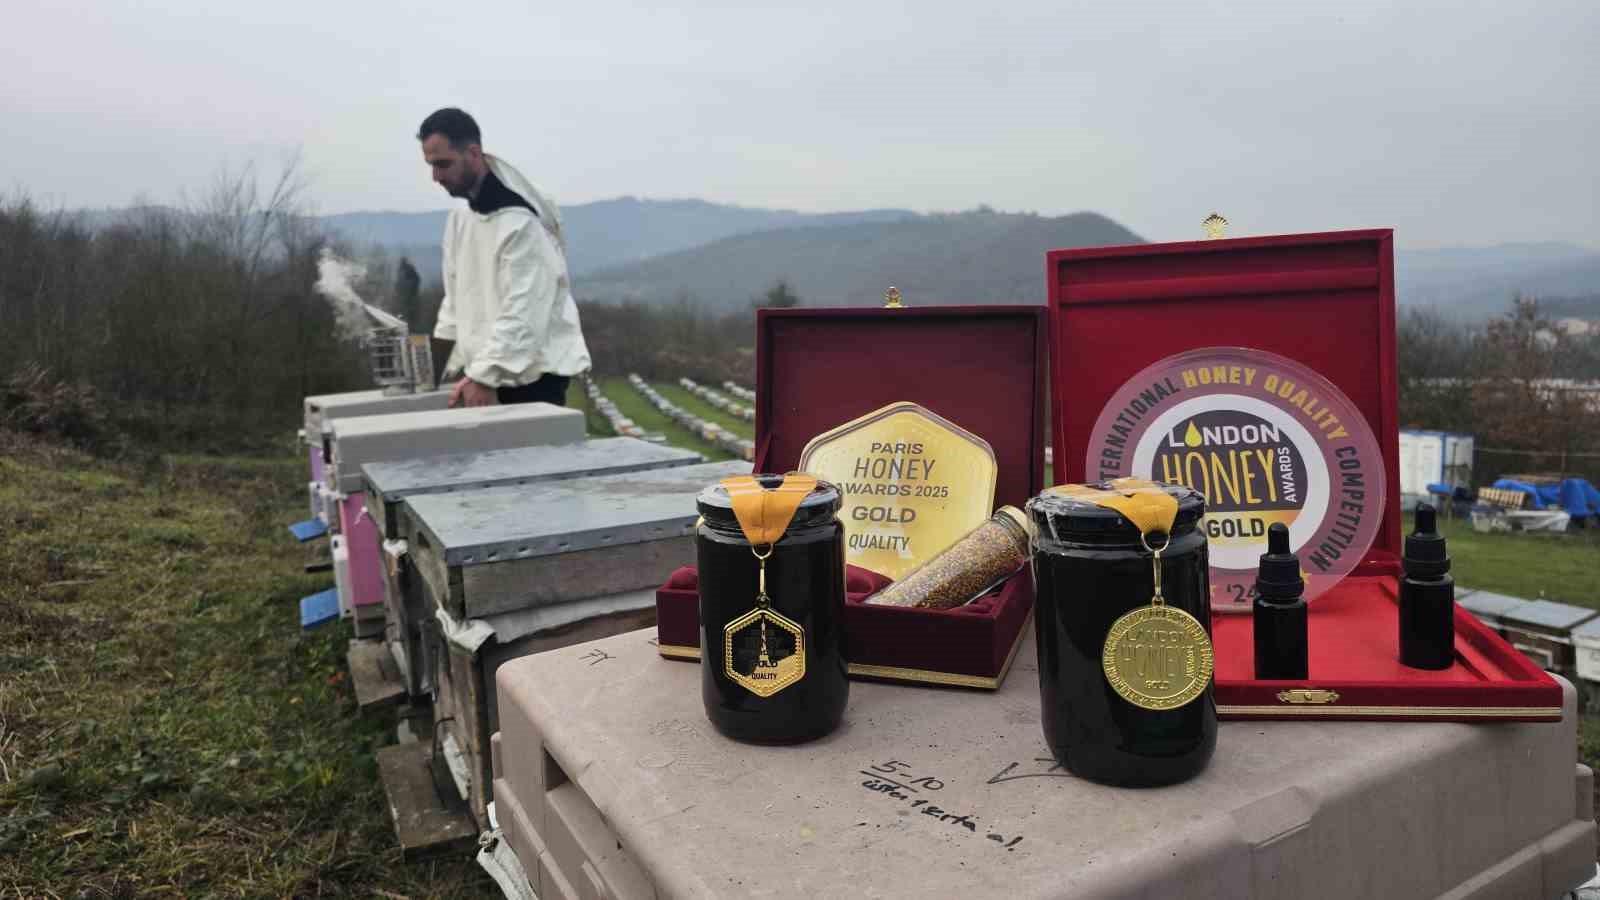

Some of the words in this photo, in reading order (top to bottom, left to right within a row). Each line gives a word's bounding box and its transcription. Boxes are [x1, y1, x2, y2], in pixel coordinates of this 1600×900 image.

[870, 442, 924, 454] PARIS
[853, 457, 936, 481] HONEY
[1100, 377, 1181, 483] TERNATIONAL
[1182, 365, 1257, 388] HONEY
[1264, 374, 1350, 440] QUALITY
[1308, 446, 1365, 571] COMPETITION
[1278, 446, 1297, 503] AWARDS
[1162, 449, 1277, 507] HONEY
[915, 485, 949, 498] 2025
[851, 506, 916, 523] GOLD
[1206, 517, 1265, 538] GOLD
[848, 533, 910, 550] QUALITY
[752, 660, 778, 668] OLD
[751, 672, 777, 680] QUALITY
[871, 761, 944, 790] 5-10
